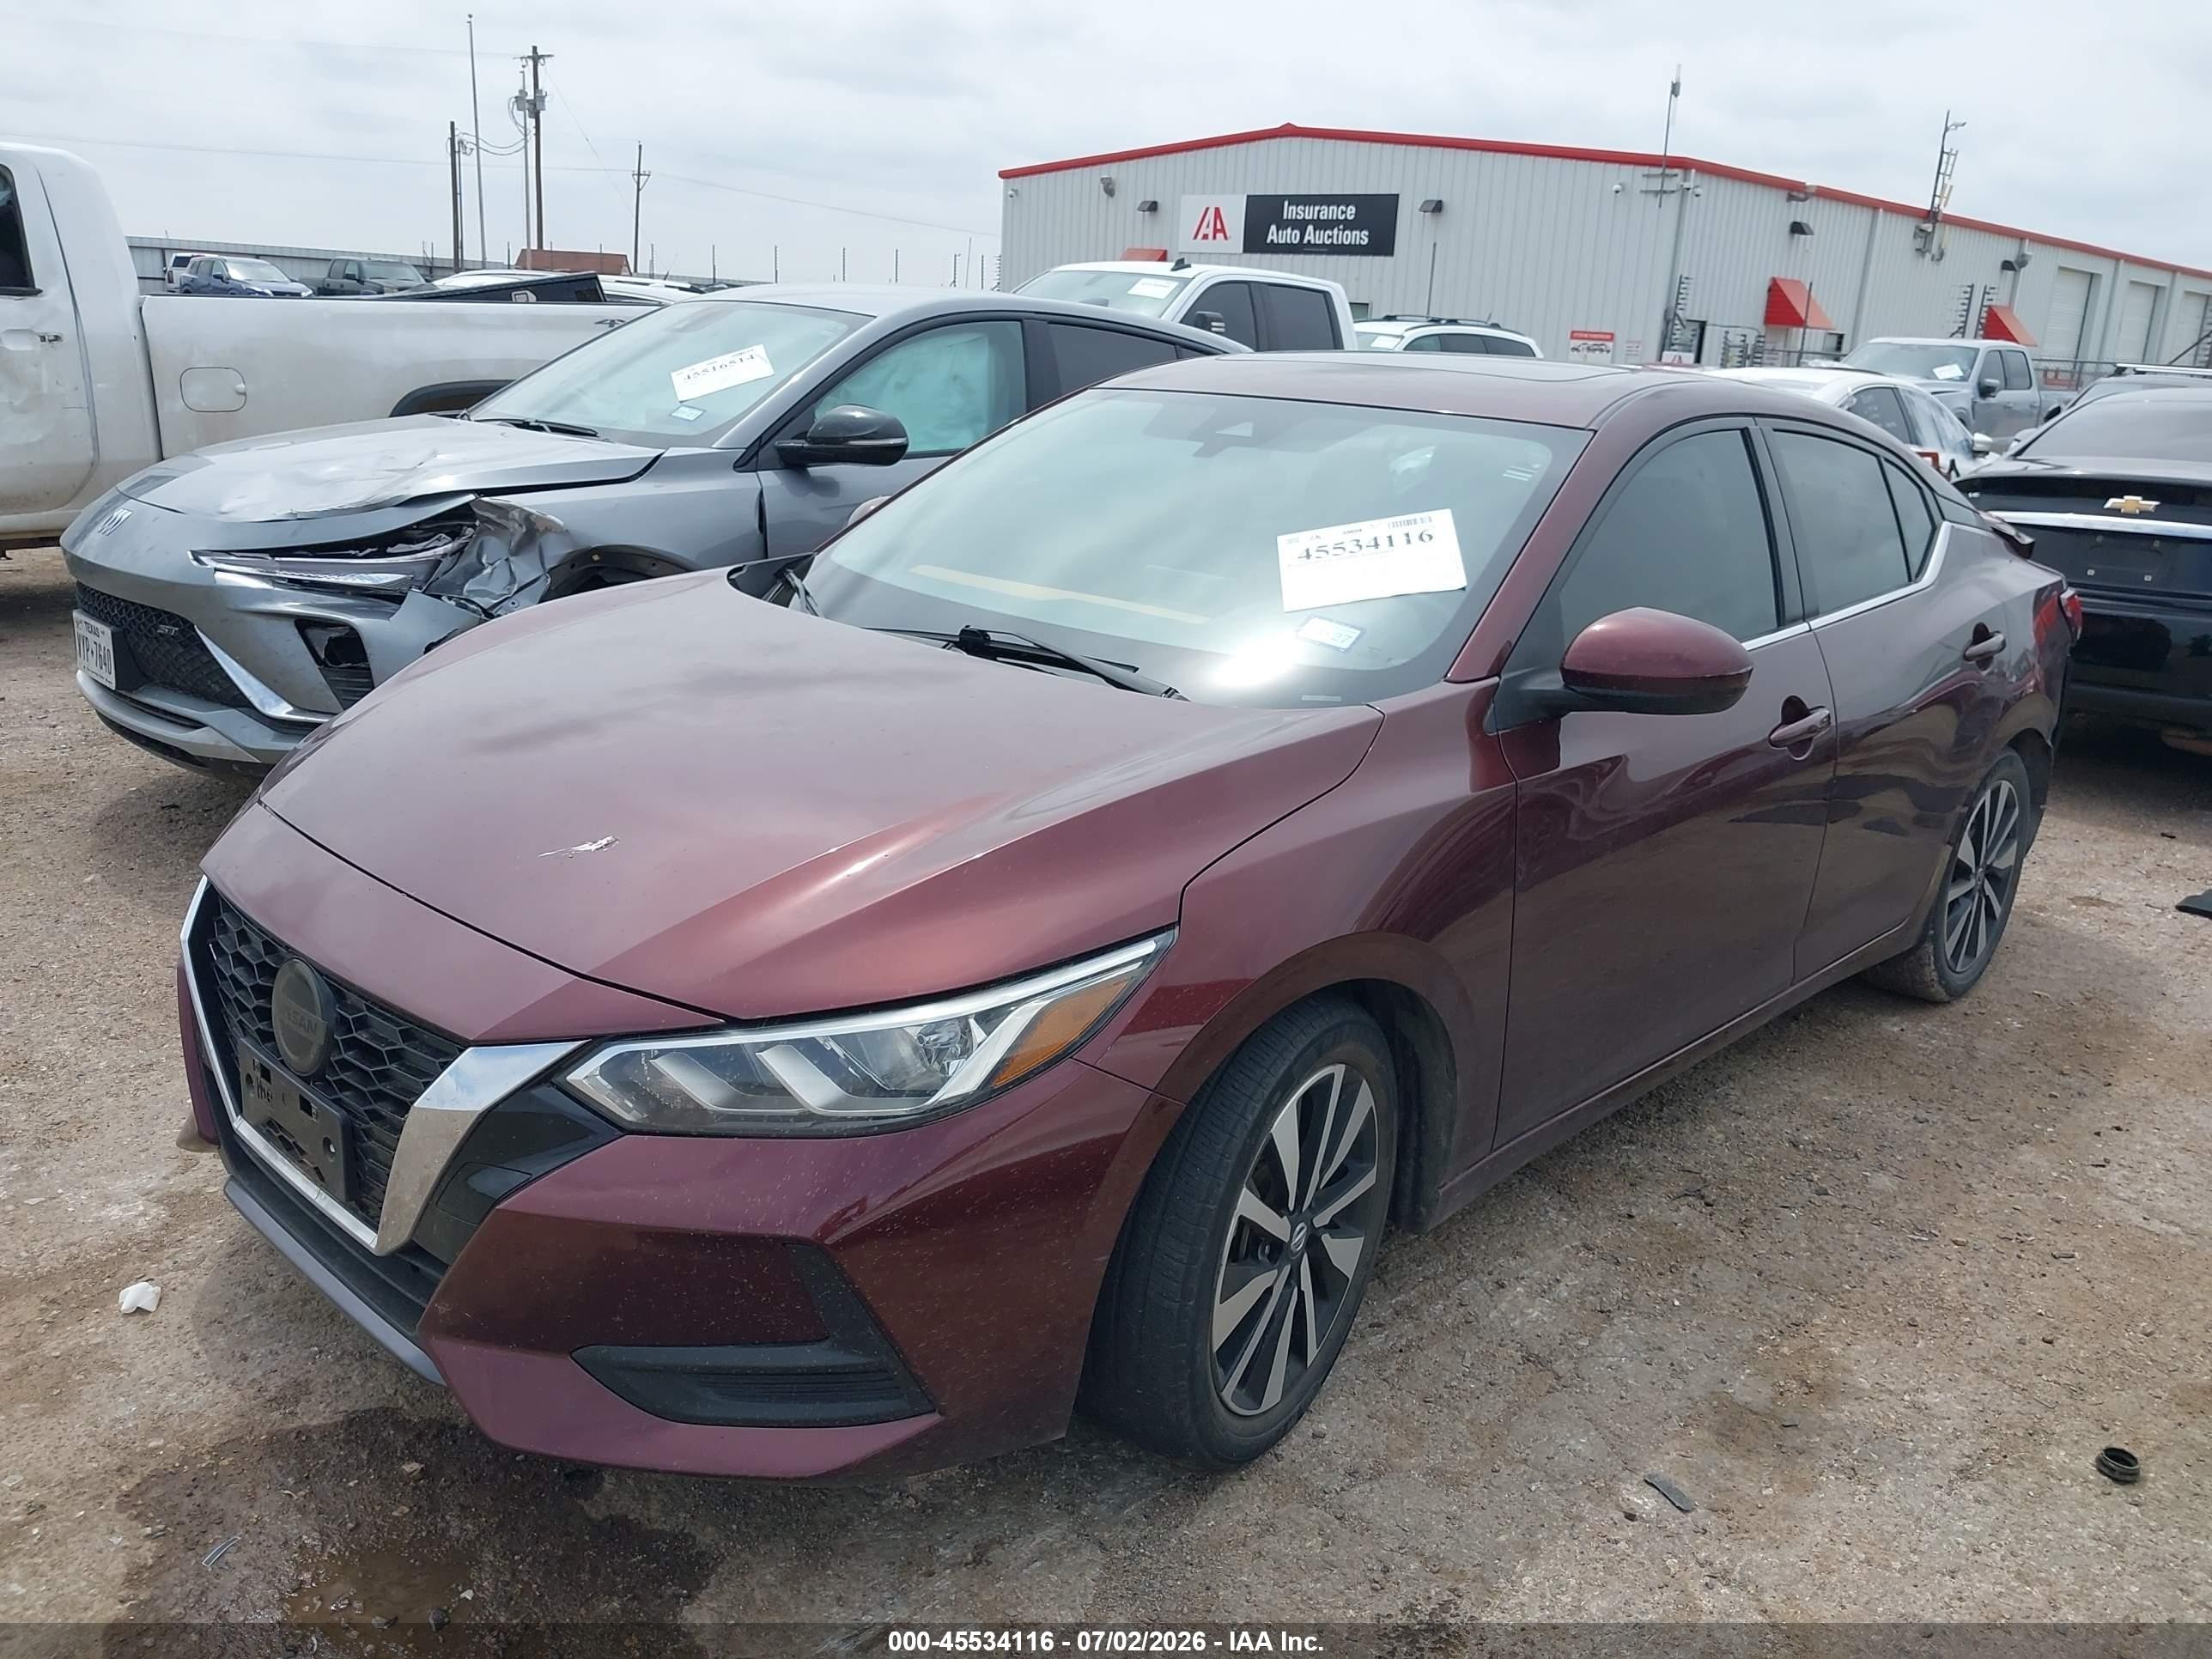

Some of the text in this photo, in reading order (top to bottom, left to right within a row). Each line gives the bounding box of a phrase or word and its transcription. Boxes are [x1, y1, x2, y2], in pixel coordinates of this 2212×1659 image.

[1282, 199, 1357, 221] Insurance
[1266, 223, 1370, 246] Auto Auctions
[1297, 527, 1434, 561] 45534116
[83, 620, 100, 638] TEXAS
[156, 623, 179, 636] ST
